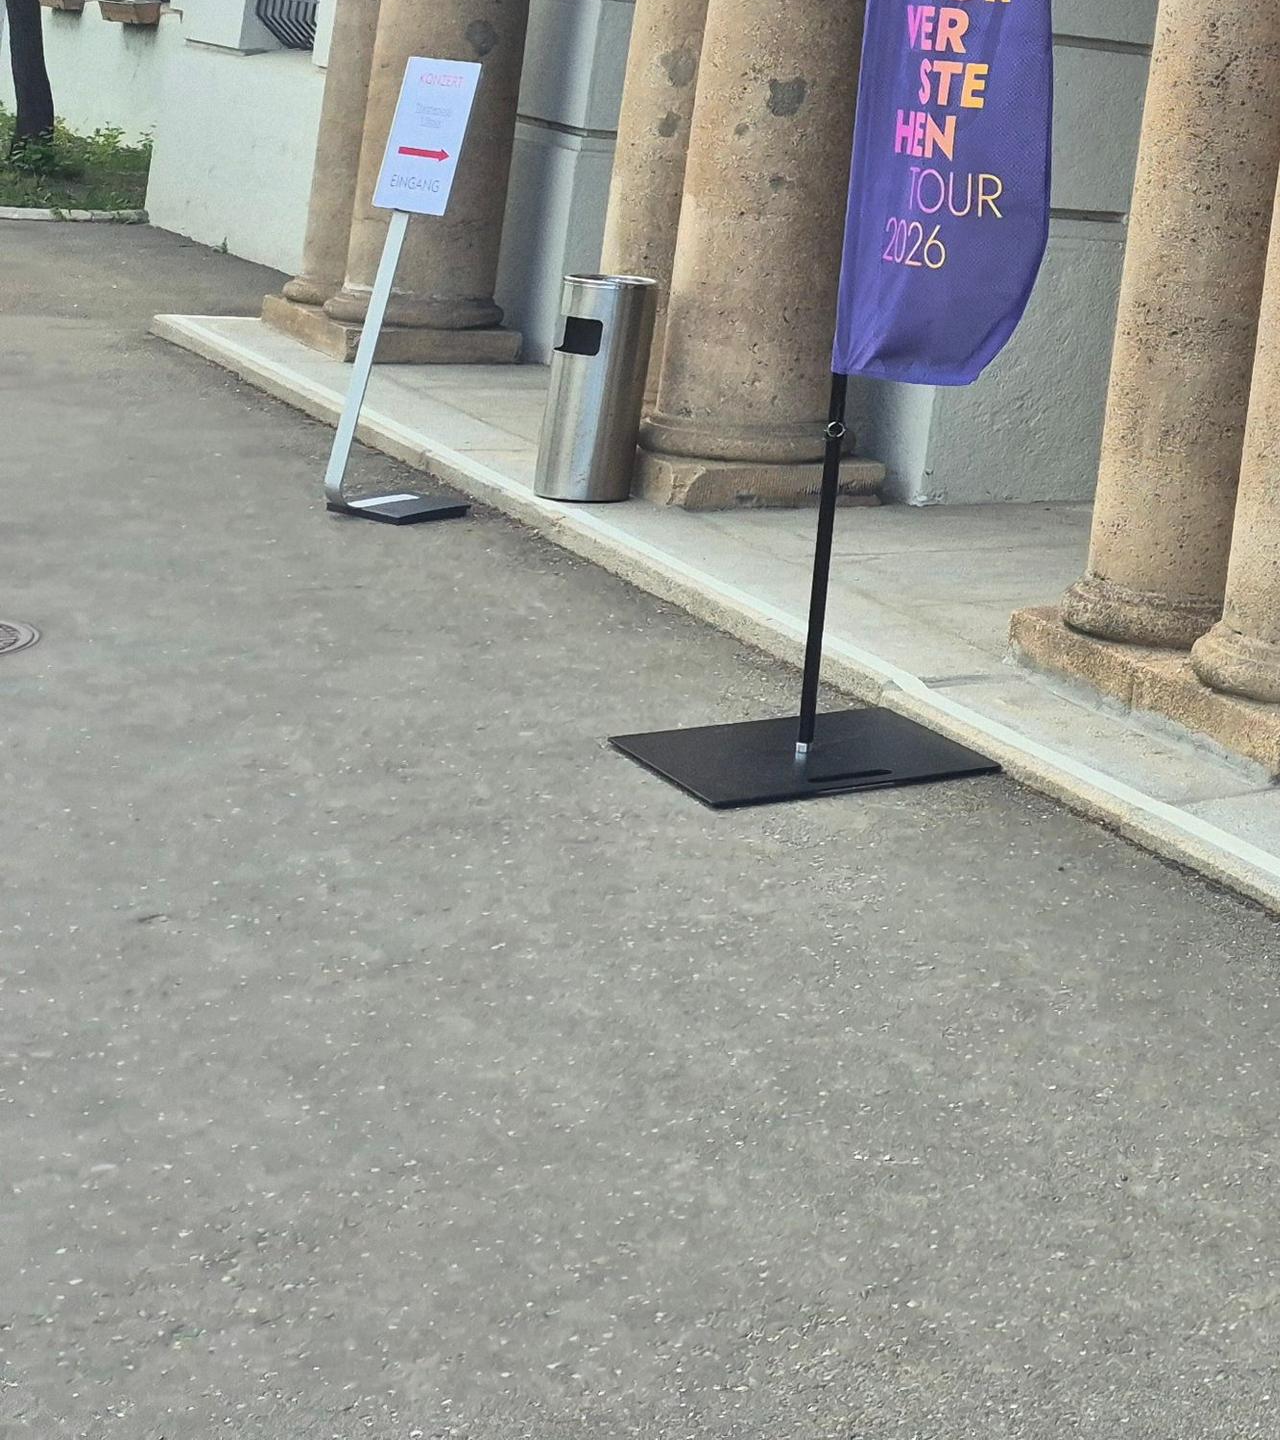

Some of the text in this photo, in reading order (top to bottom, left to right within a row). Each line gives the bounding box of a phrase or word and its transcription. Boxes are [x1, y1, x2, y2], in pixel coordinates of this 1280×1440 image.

[907, 4, 970, 54] VER
[918, 57, 989, 109] STE
[895, 109, 957, 162] HEN
[390, 174, 440, 193] EINGANG
[908, 166, 1003, 219] TOUR
[882, 217, 946, 269] 2026
